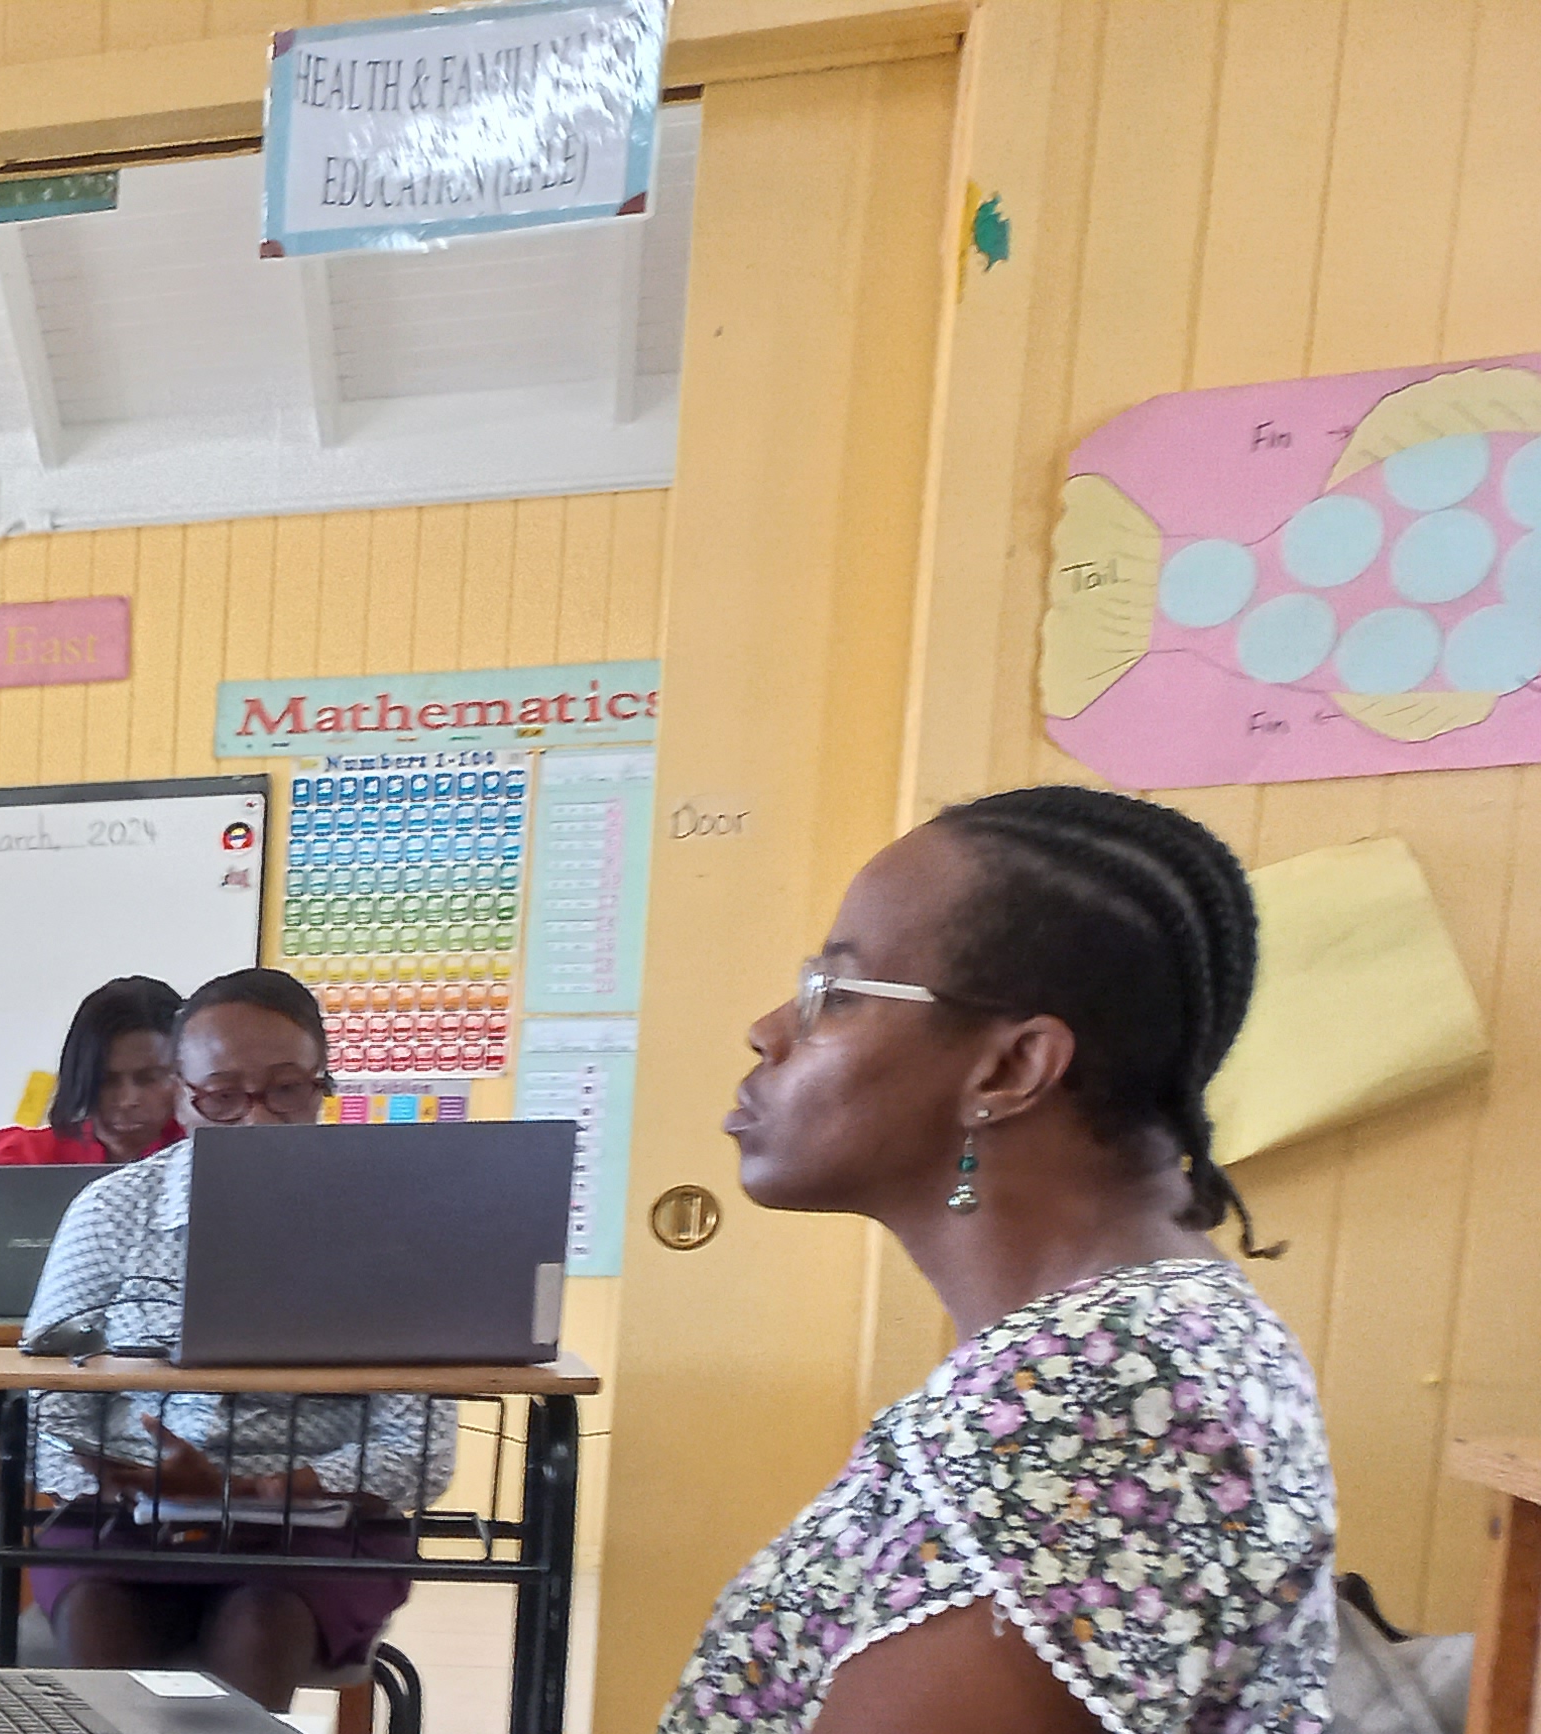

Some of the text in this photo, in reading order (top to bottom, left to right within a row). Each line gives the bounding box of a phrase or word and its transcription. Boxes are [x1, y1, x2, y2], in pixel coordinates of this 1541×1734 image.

[296, 51, 403, 111] HEALTH
[409, 57, 431, 111] &
[1251, 420, 1292, 451] Fin
[4, 626, 99, 666] East
[236, 679, 659, 736] Mathematics
[325, 750, 496, 772] Numbers 1-100
[670, 802, 751, 839] Door
